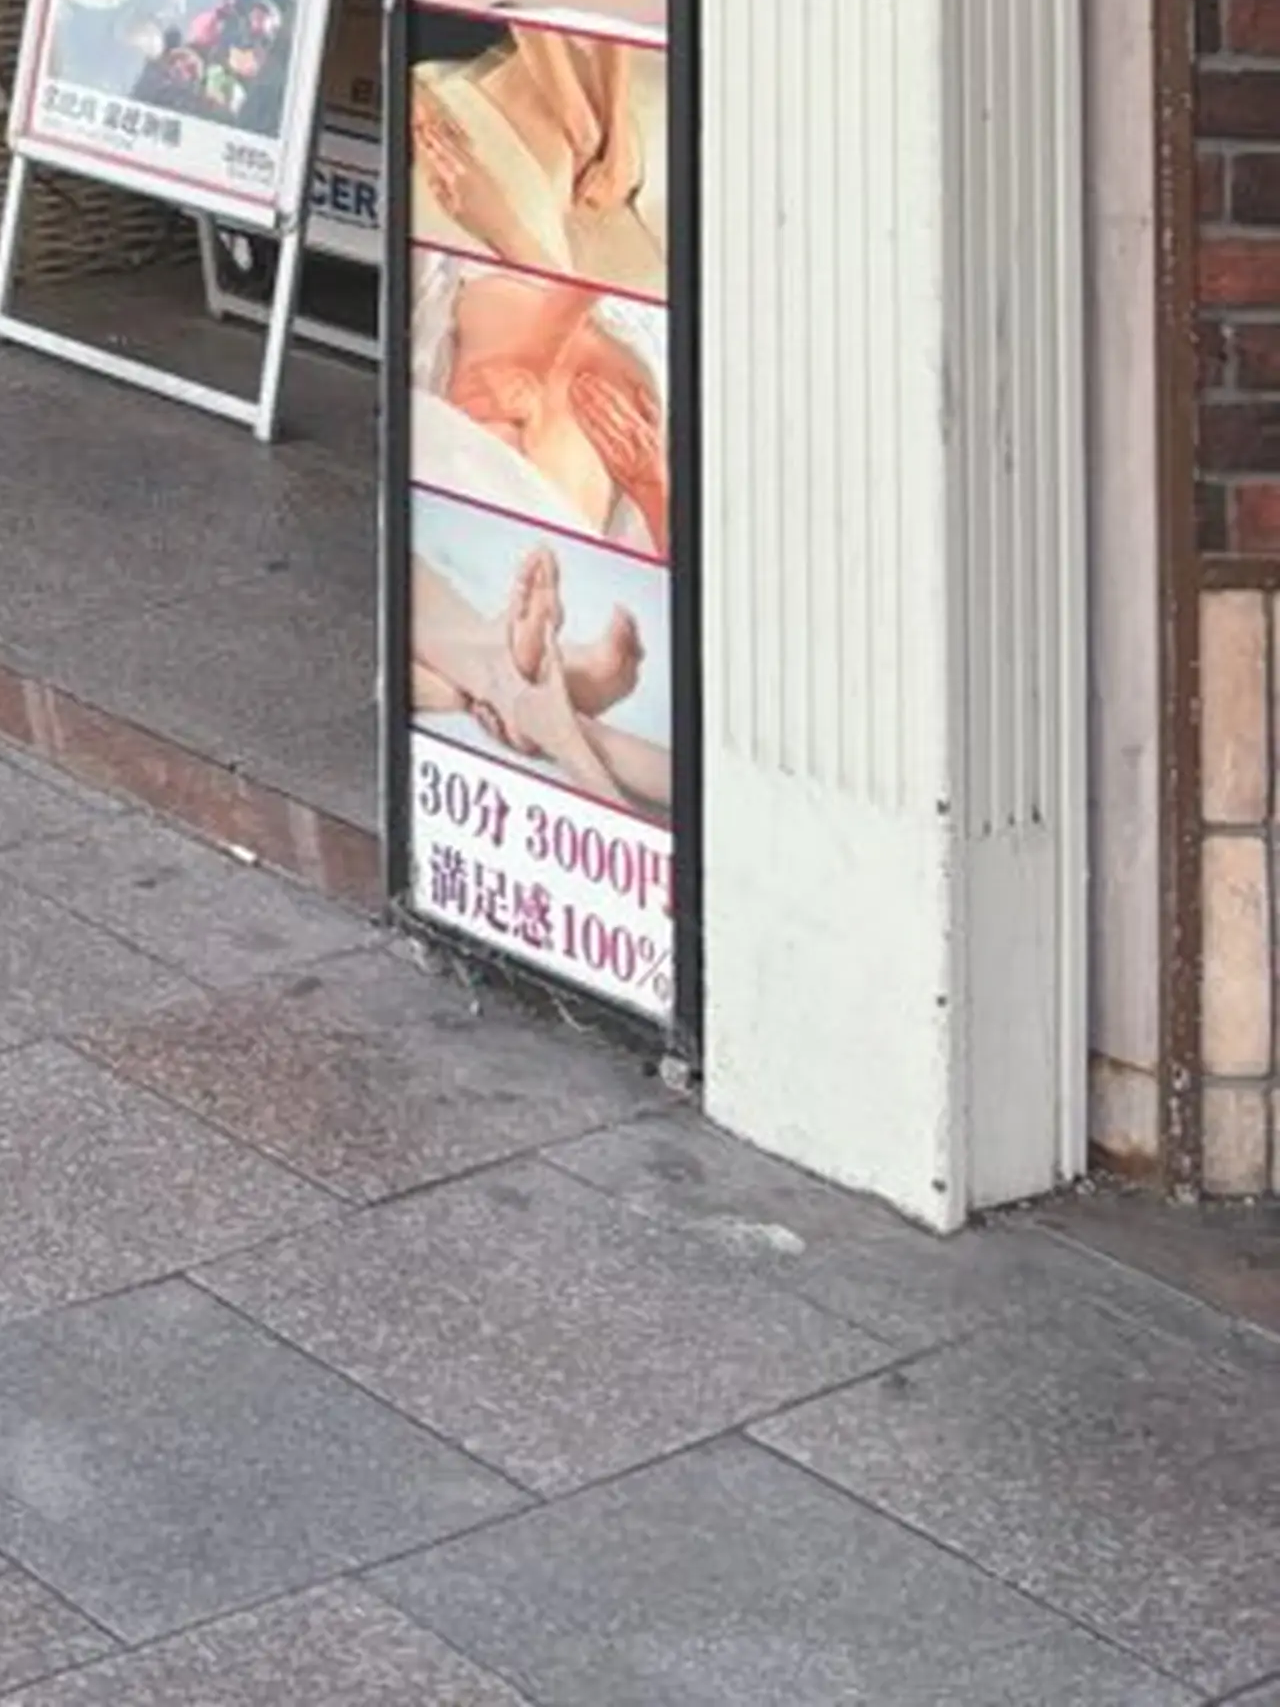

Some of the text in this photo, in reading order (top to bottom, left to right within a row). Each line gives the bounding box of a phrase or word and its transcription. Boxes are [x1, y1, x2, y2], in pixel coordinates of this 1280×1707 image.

[419, 760, 677, 919] 30分 3000円
[429, 841, 673, 1003] 満足感100%
